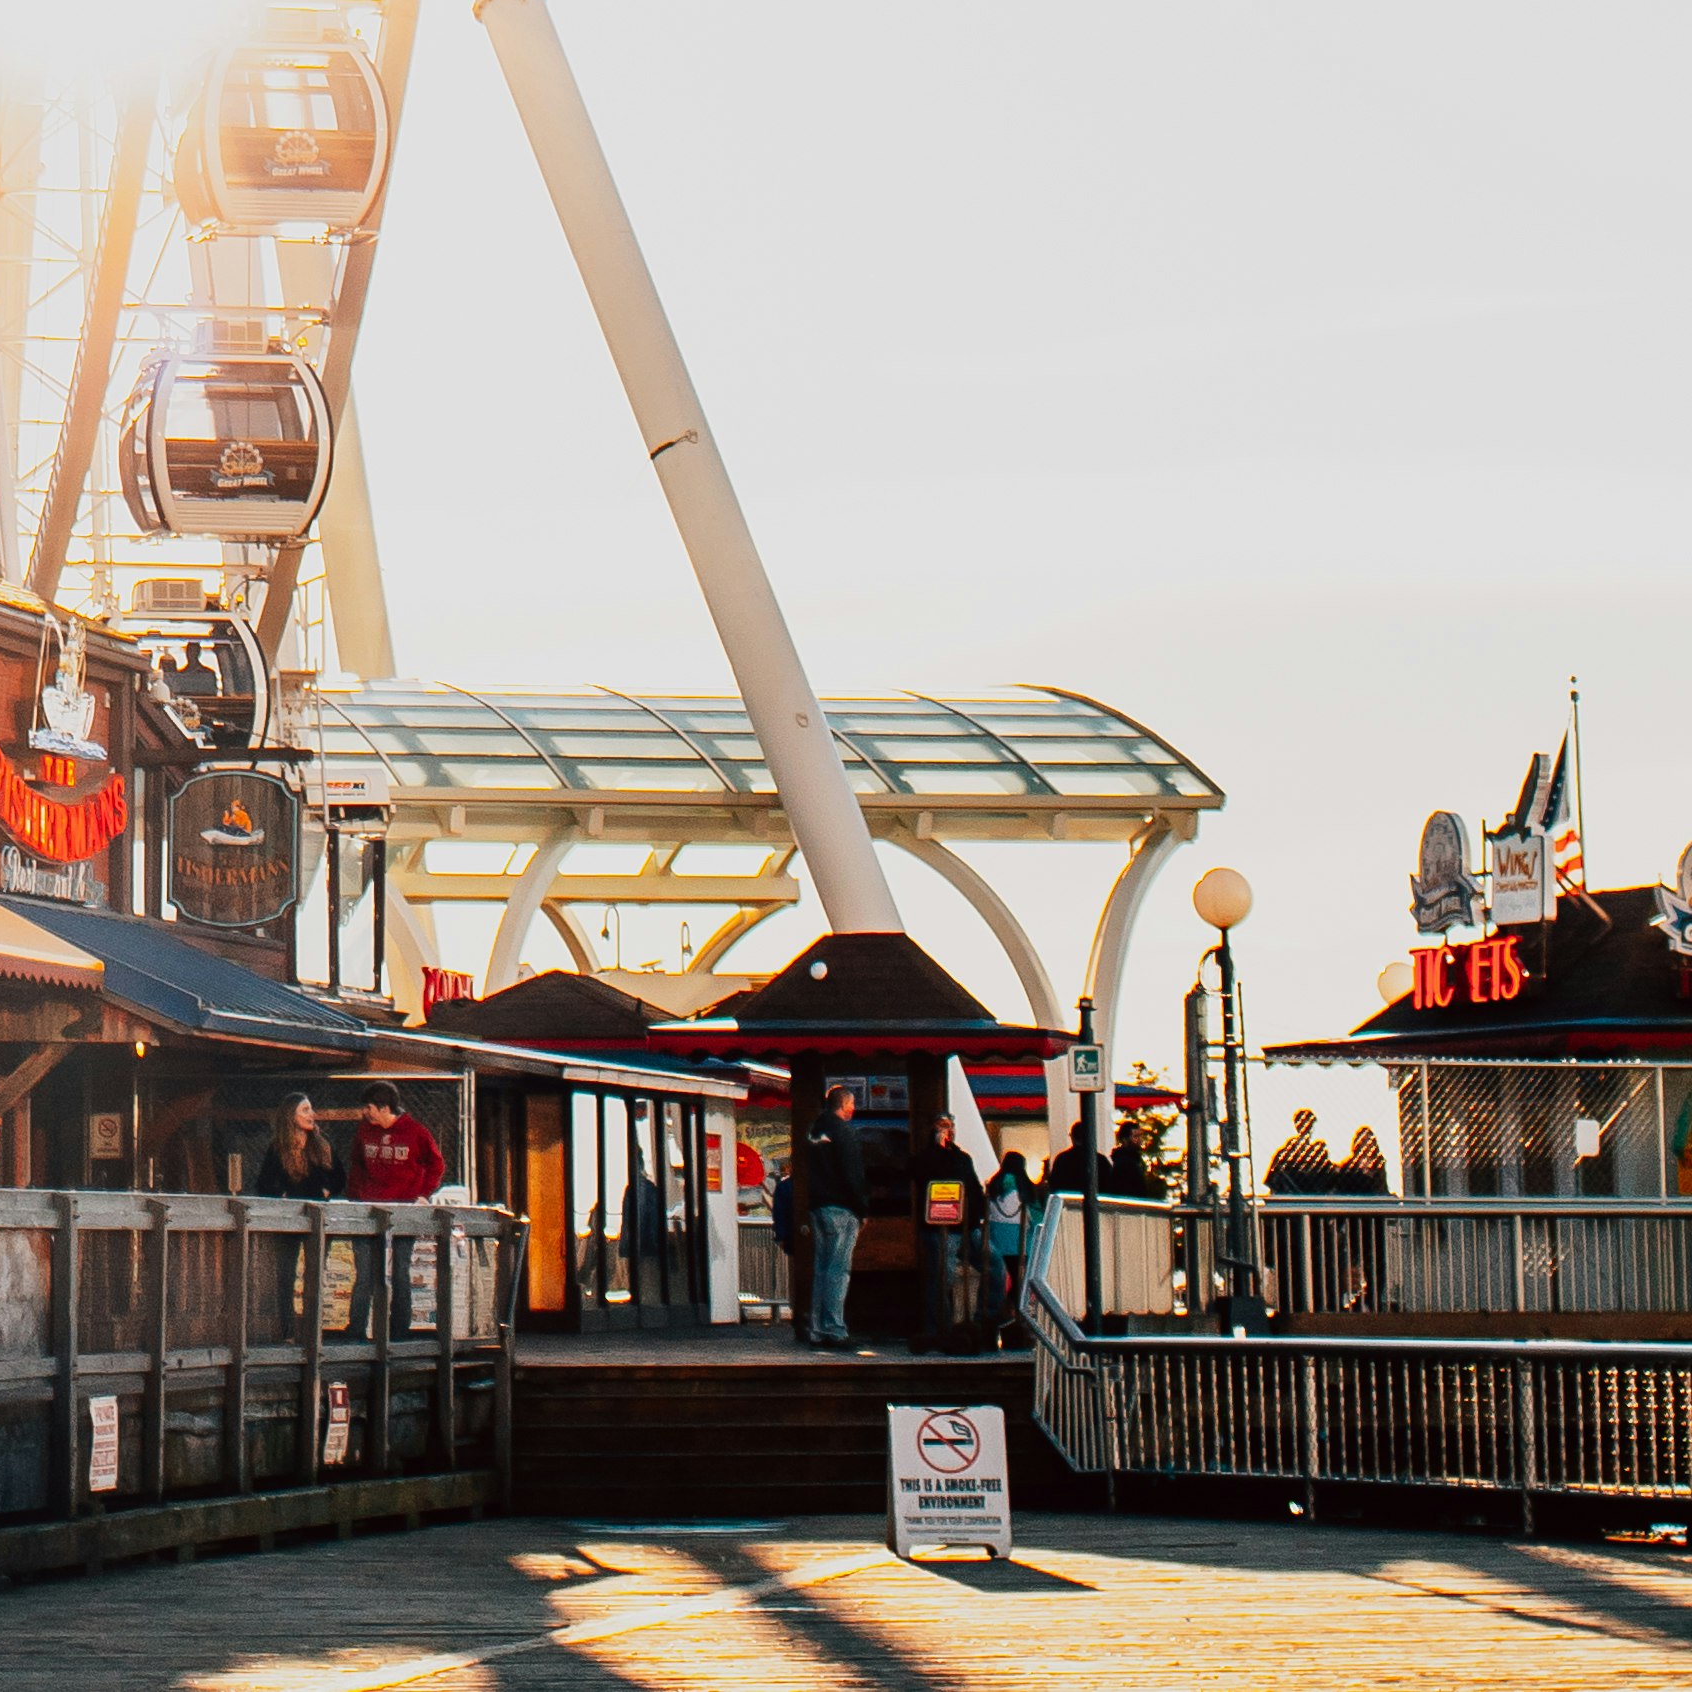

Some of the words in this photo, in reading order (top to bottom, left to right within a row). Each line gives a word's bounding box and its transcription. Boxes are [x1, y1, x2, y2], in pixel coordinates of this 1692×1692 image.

[43, 754, 76, 788] THE
[1411, 934, 1524, 1011] TICETS
[900, 1478, 921, 1492] THIS
[923, 1478, 933, 1492] IS
[936, 1478, 943, 1492] A
